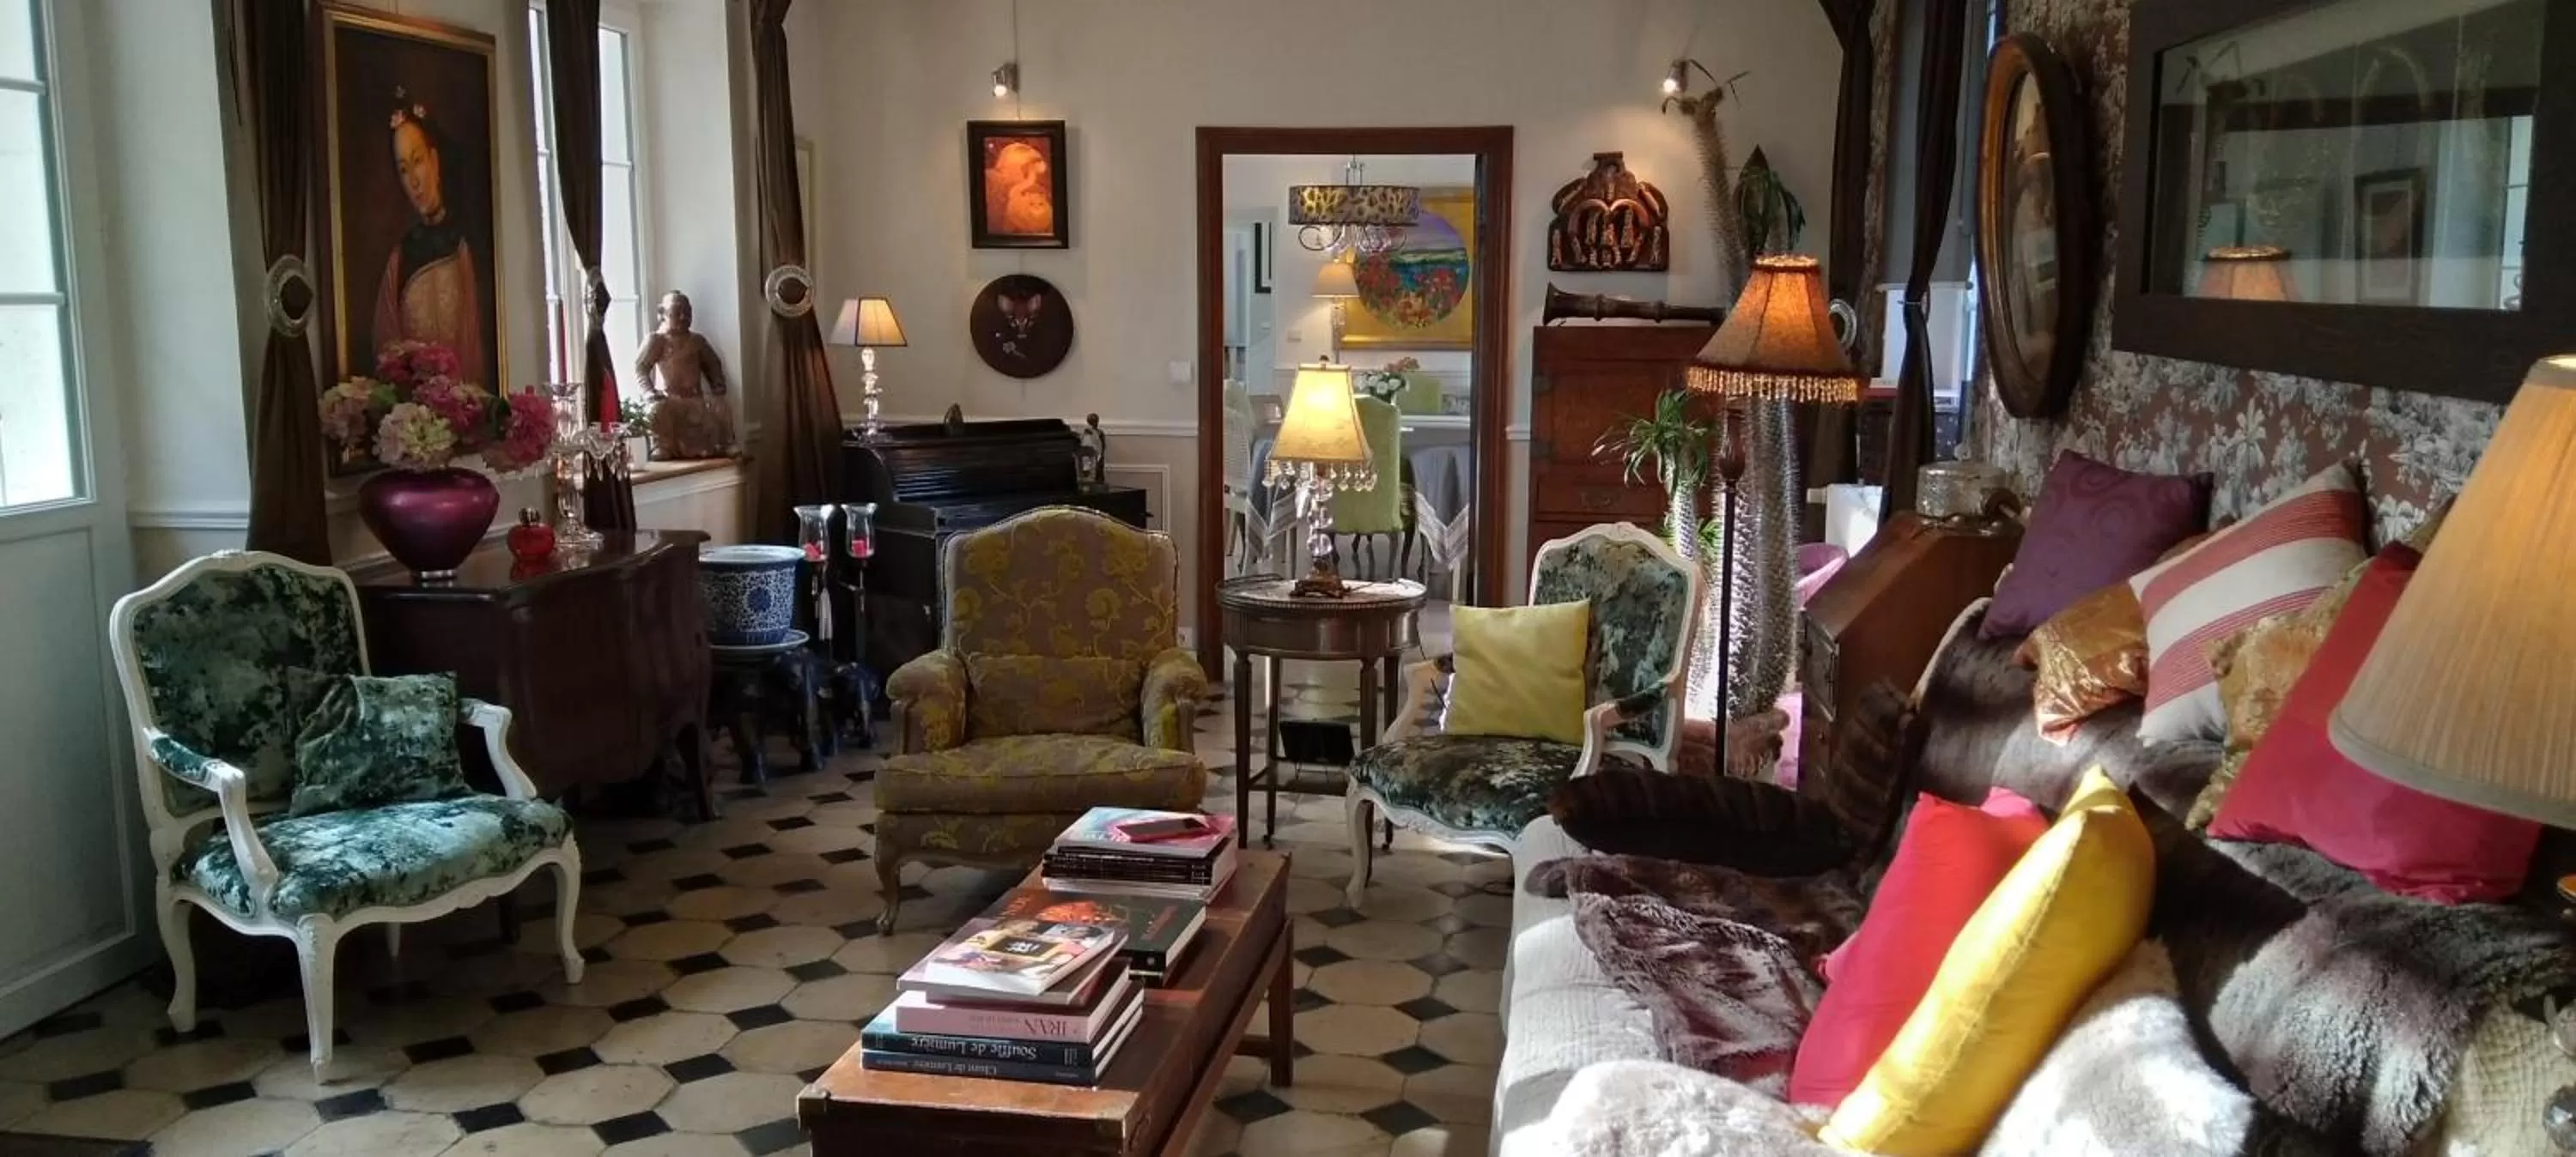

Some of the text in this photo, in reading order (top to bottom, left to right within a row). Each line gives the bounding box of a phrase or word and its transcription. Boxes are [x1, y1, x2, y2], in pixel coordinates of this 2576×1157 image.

[1024, 1018, 1067, 1037] IRAN
[970, 1043, 987, 1056] de
[990, 1043, 1037, 1060] Souffle
